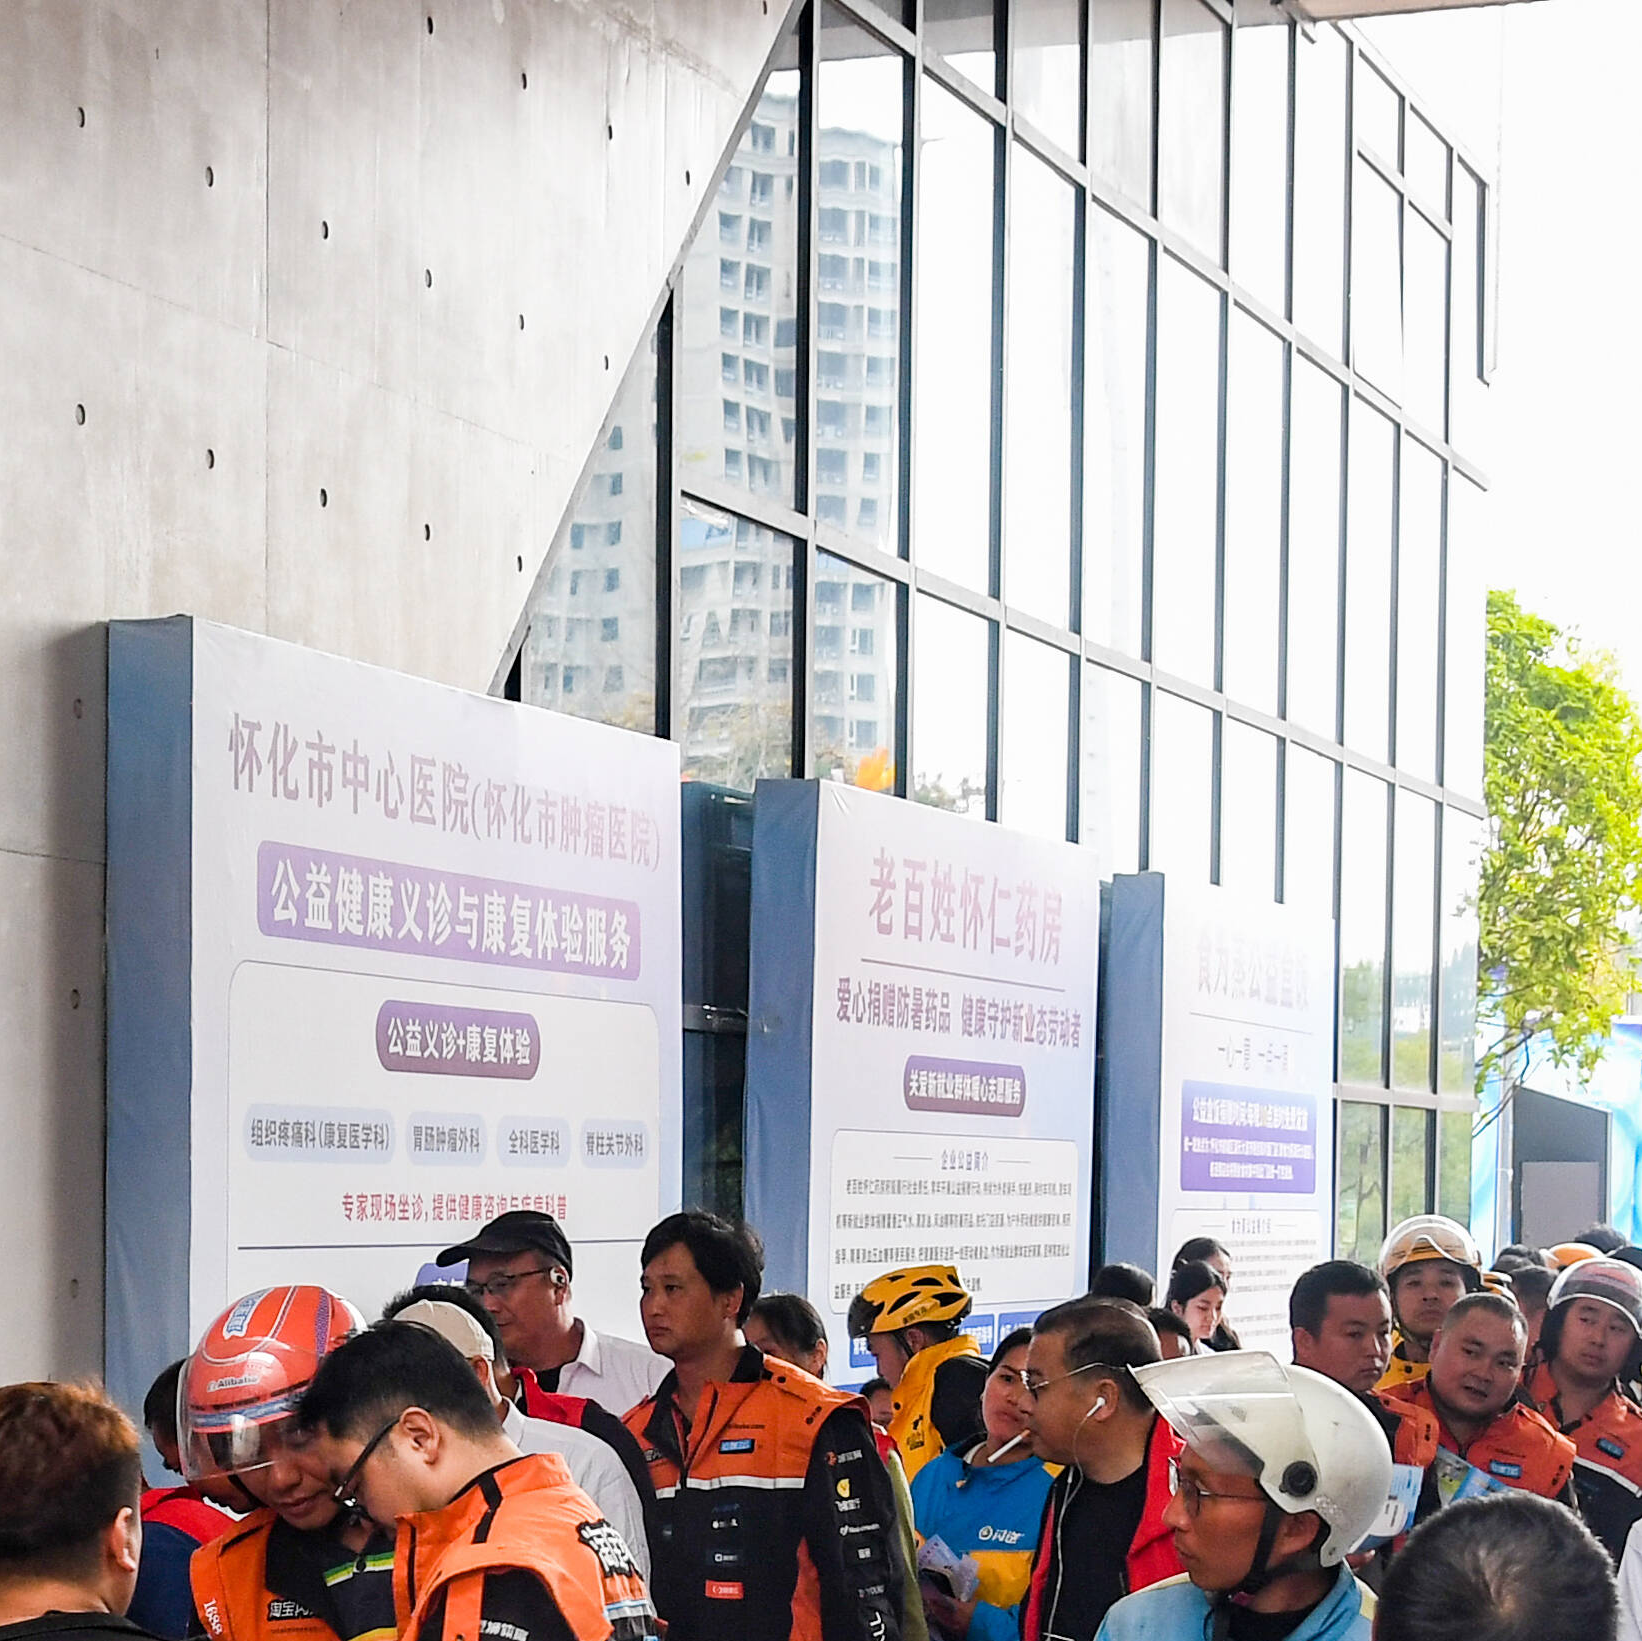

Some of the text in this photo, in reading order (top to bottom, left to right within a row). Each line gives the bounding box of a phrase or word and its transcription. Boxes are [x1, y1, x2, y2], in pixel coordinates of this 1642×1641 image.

[271, 858, 632, 970] 公益健康义诊与康复体验服务
[868, 847, 1063, 966] 老百姓怀仁药房
[386, 1016, 531, 1066] 公益义诊+康复体验
[508, 1129, 560, 1156] 全科医学科
